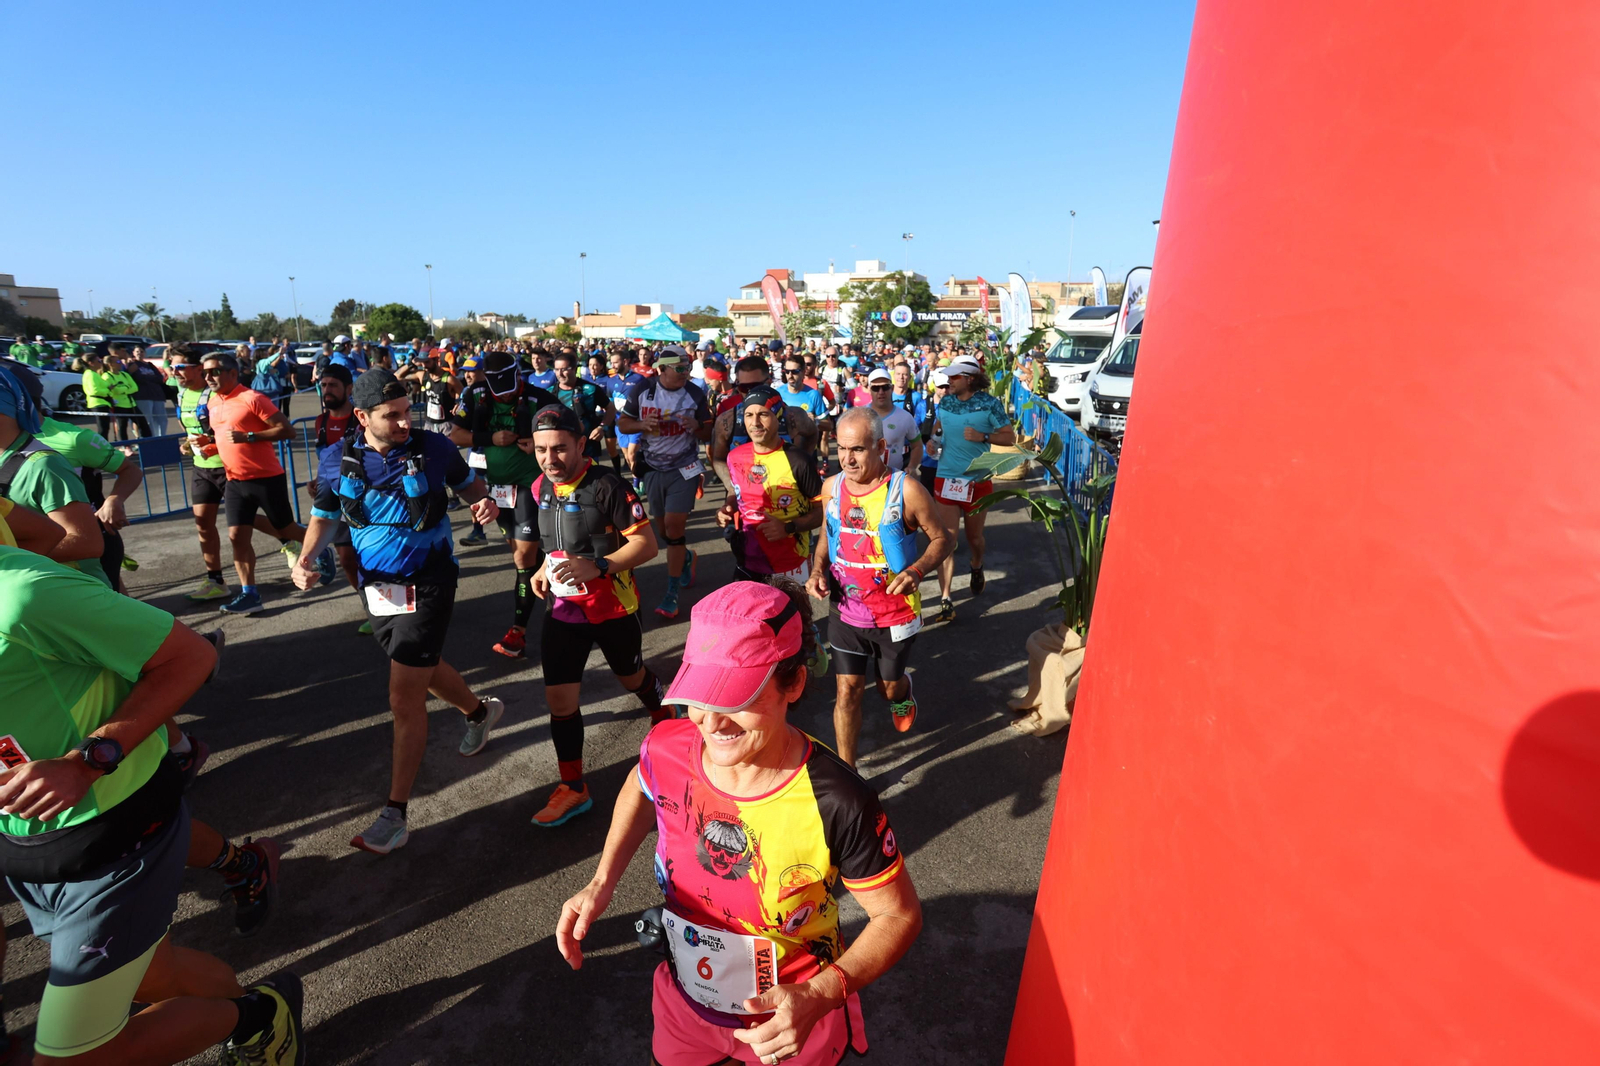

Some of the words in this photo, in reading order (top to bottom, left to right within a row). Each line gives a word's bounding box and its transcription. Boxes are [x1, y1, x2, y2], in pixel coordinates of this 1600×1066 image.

[917, 312, 939, 321] TRAIL
[940, 312, 967, 321] PIRATA
[949, 484, 963, 493] 246
[496, 490, 507, 499] 364
[666, 918, 674, 928] 10
[699, 938, 726, 950] PIRATA
[697, 956, 713, 980] 6
[694, 982, 719, 994] MENDOZA
